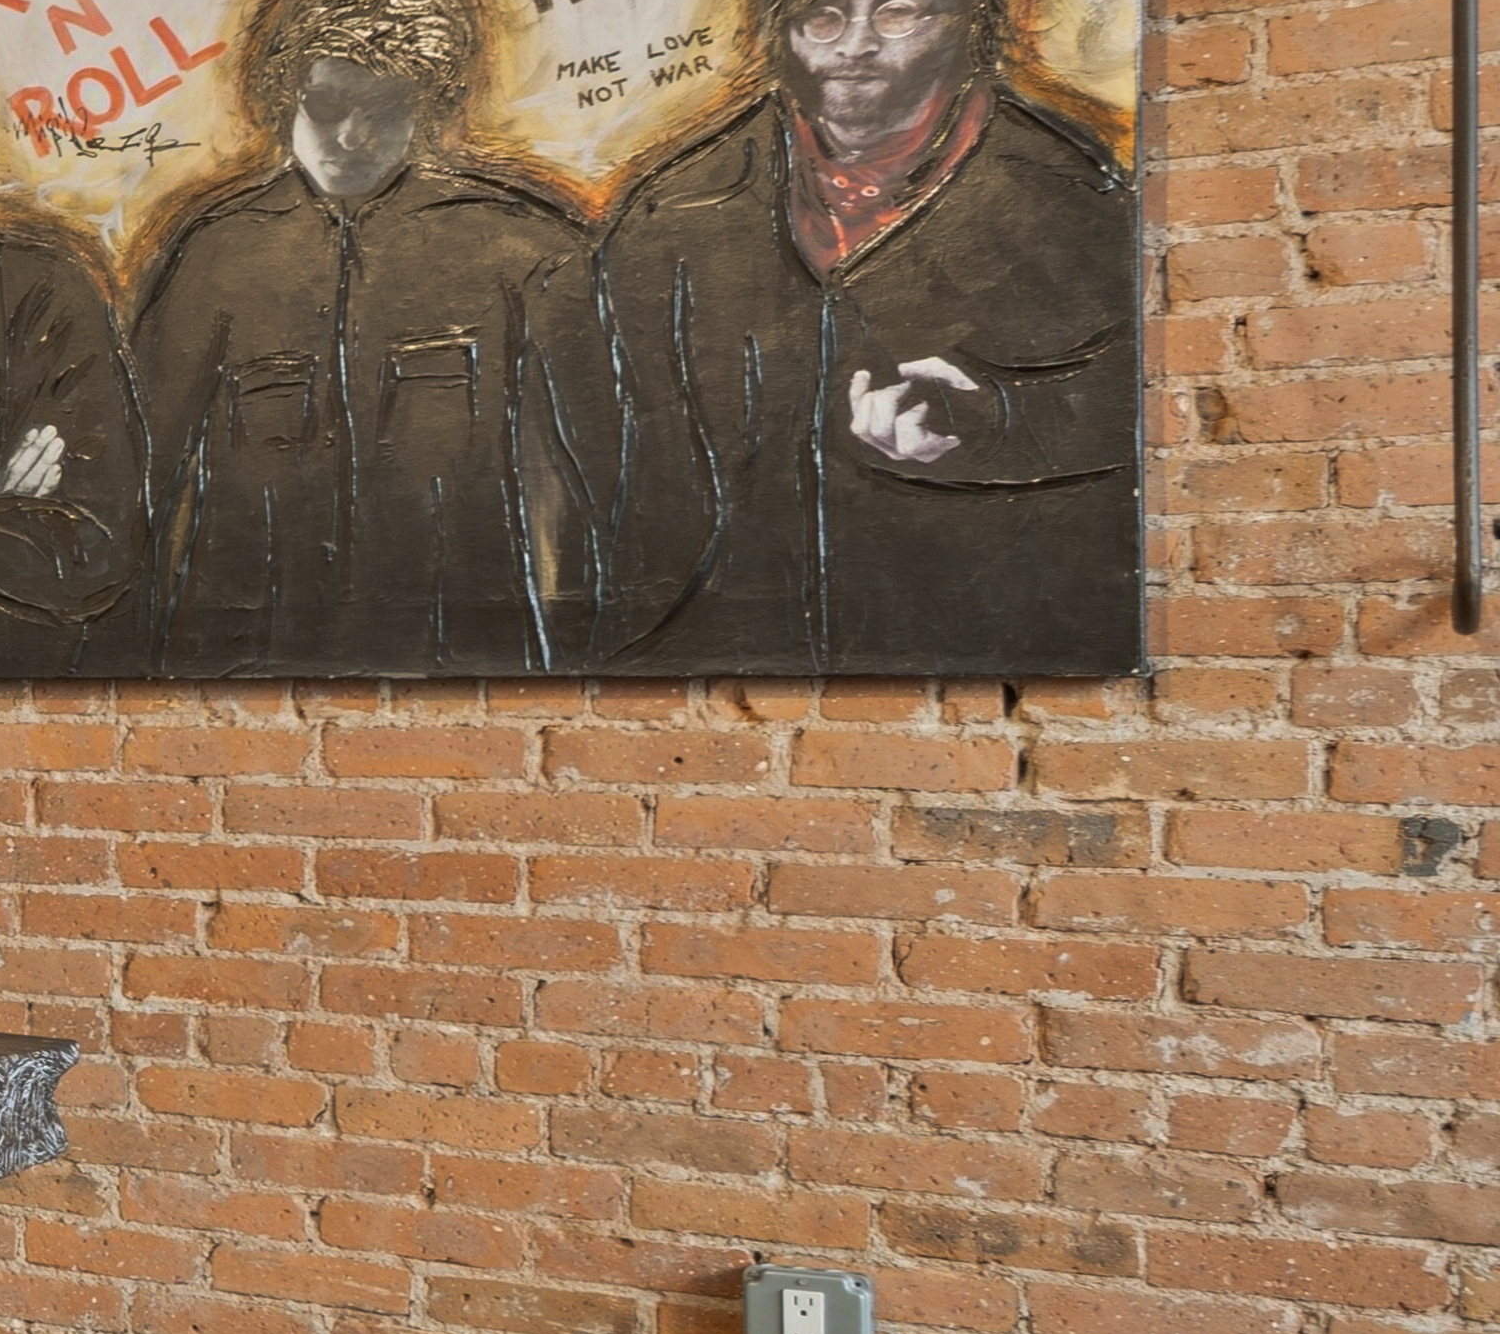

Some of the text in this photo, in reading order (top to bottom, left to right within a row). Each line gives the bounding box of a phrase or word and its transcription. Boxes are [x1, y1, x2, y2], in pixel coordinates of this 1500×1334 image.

[556, 26, 714, 81] MAKE LOVE
[9, 15, 229, 159] ROLL
[578, 55, 713, 109] NOT WAR
